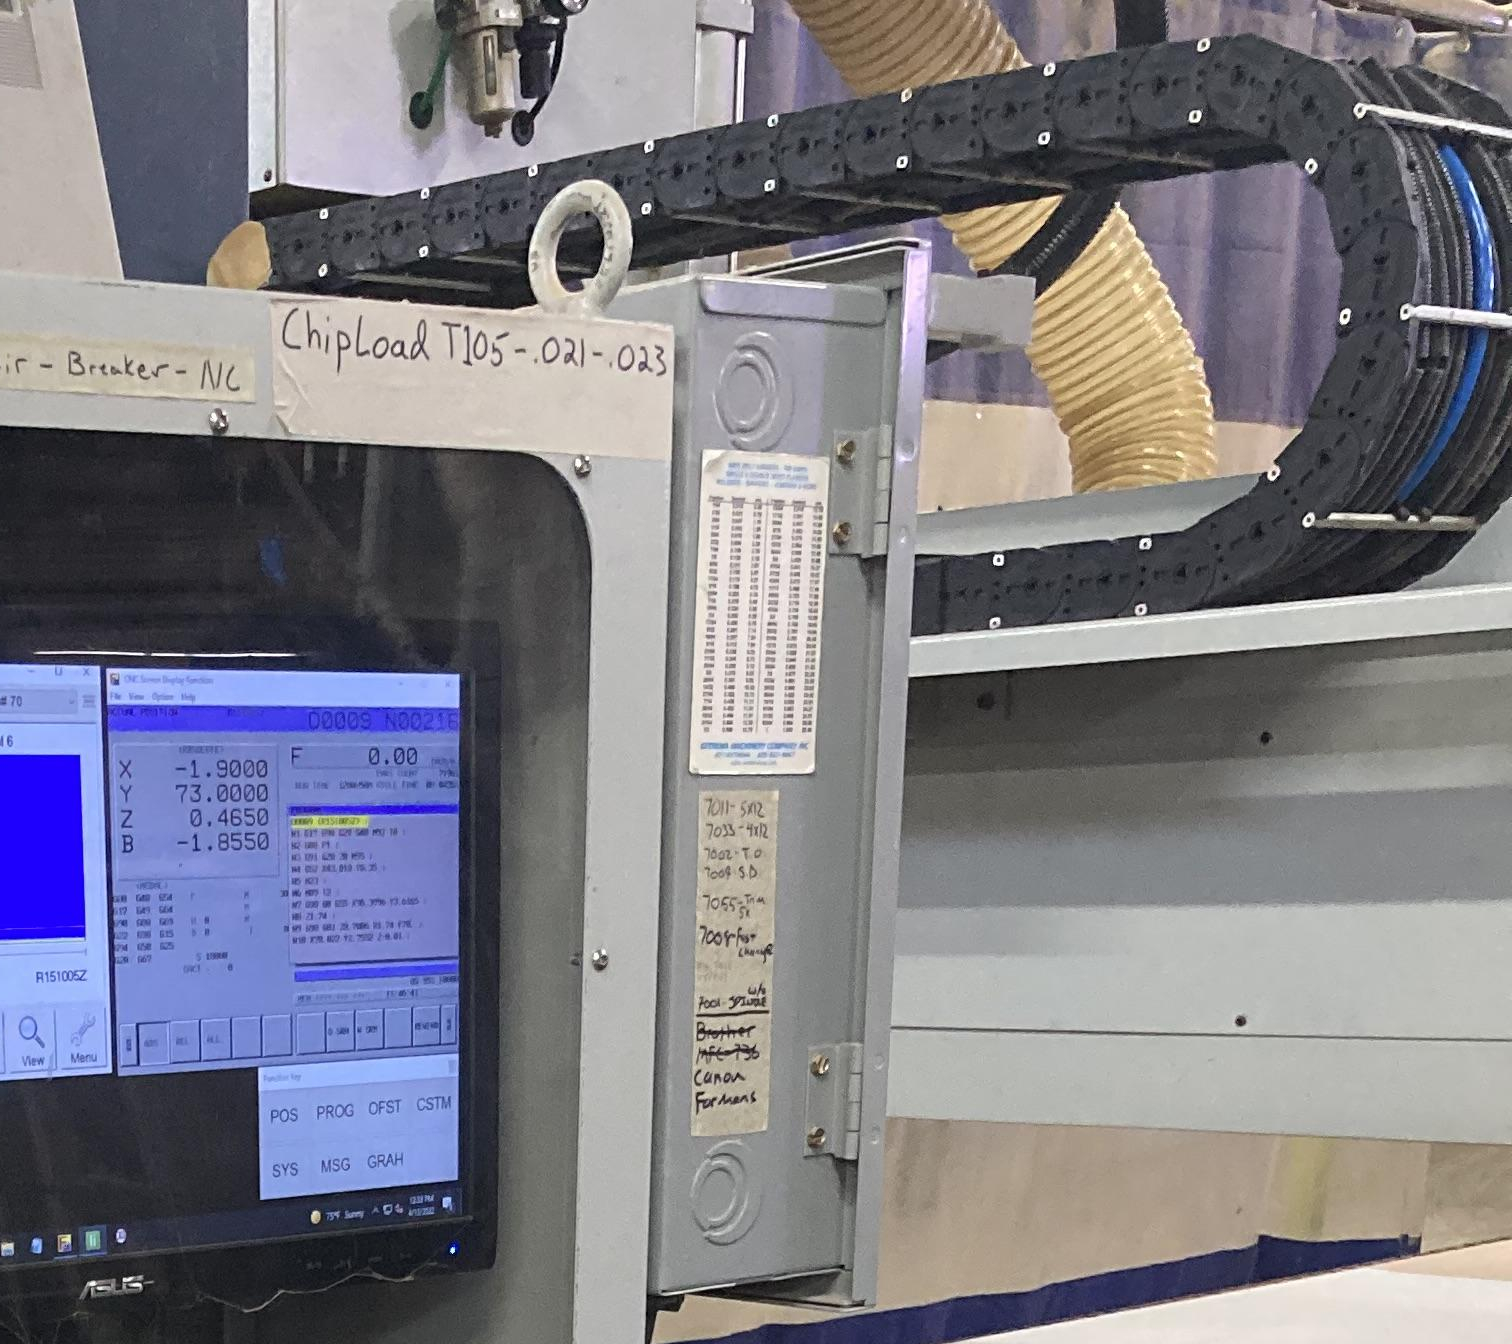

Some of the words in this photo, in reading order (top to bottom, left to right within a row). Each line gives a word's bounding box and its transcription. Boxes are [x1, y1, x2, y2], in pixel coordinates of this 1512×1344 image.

[67, 351, 168, 381] Breaker
[200, 360, 241, 393] NC
[10, 695, 23, 707] 70
[291, 748, 303, 764] F
[368, 747, 418, 766] 0.00
[119, 760, 132, 779] X
[175, 759, 269, 779] -1.9000
[120, 785, 132, 801] Y
[175, 784, 269, 802] 73.0000
[121, 810, 133, 828] Z
[190, 808, 269, 827] 0.4650
[122, 834, 134, 853] B
[177, 832, 270, 852] -1.8550
[21, 1054, 45, 1068] View
[70, 1050, 98, 1065] Menu
[270, 1108, 298, 1123] POS
[316, 1104, 354, 1120] PROG
[368, 1100, 402, 1115] OFST
[416, 1096, 452, 1111] CSTM
[272, 1162, 299, 1178] SYS
[321, 1158, 351, 1174] MSG
[367, 1153, 404, 1169] GRAH
[79, 1275, 154, 1300] ASUS
